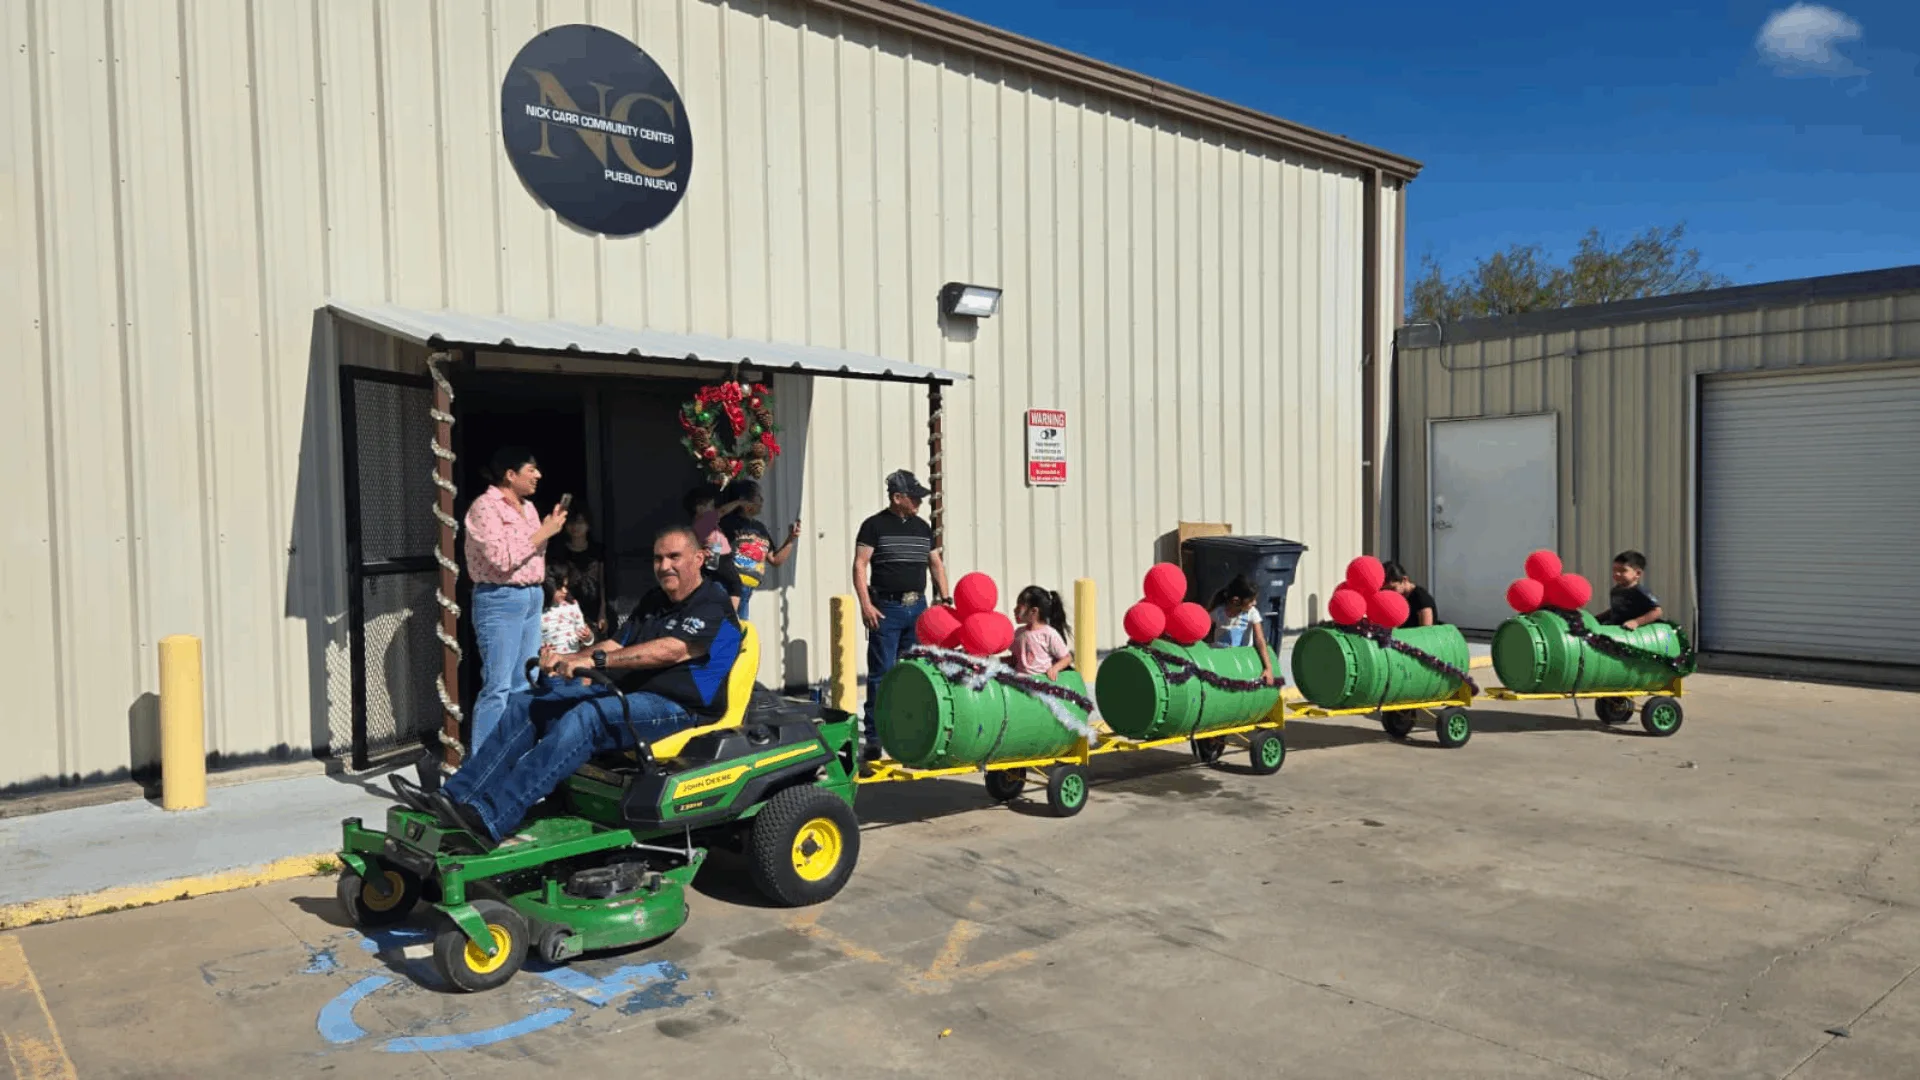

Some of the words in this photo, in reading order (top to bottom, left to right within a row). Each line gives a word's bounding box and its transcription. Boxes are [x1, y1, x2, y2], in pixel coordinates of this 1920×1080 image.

[523, 67, 677, 177] NC
[525, 104, 551, 120] NICK
[552, 109, 579, 125] CARR
[581, 115, 639, 138] COMMUNITY
[639, 127, 675, 144] CENTER
[604, 169, 643, 186] PUEBLO
[644, 177, 677, 192] NUEVO
[1031, 411, 1064, 426] WARNING
[683, 780, 704, 792] JOHN
